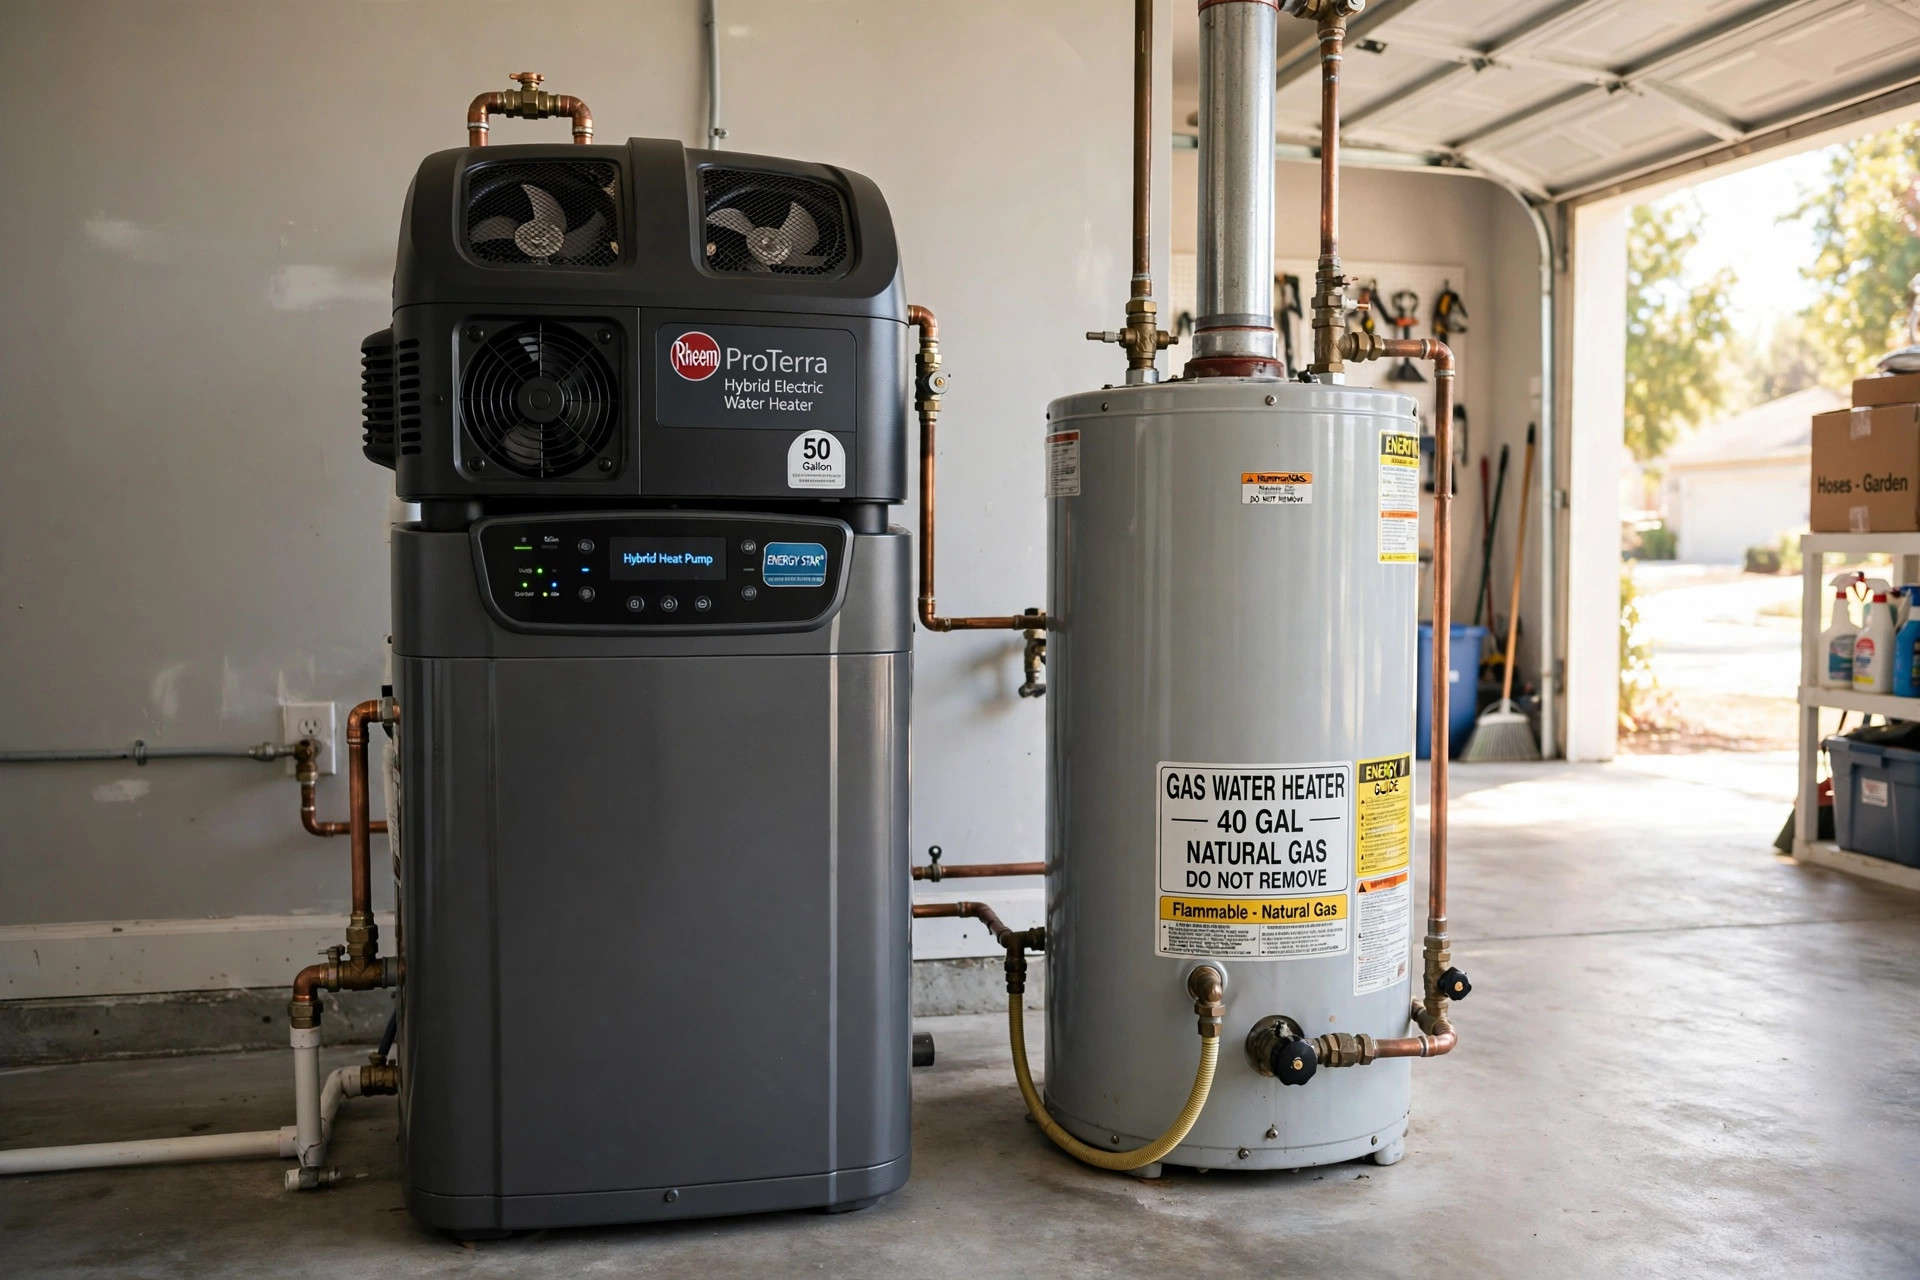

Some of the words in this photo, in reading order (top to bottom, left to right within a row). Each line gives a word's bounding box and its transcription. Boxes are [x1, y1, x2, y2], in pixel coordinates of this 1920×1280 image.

[675, 339, 718, 369] Rheem
[726, 347, 828, 374] ProTerra
[724, 378, 770, 396] Hybrid
[774, 379, 824, 394] Electric
[724, 395, 765, 410] Water
[769, 397, 814, 412] Heater
[803, 437, 831, 460] 50
[802, 461, 832, 471] Gallon
[1817, 476, 1852, 494] Hoses
[1863, 472, 1908, 493] Garden
[623, 552, 657, 566] Hybrid
[659, 553, 683, 564] Heat
[684, 553, 714, 566] Pump
[767, 554, 800, 566] ENERGY
[1166, 772, 1206, 801] GAS
[1212, 774, 1276, 801] WATER
[1282, 772, 1346, 800] HEATER
[1217, 809, 1247, 834] 40
[1255, 808, 1304, 834] GAL
[1186, 840, 1282, 865] NATURAL
[1288, 838, 1327, 864] GAS
[1186, 870, 1211, 888] DO
[1217, 871, 1254, 889] NOT
[1259, 868, 1327, 889] REMOVE
[1172, 901, 1248, 920] Flammable
[1261, 902, 1310, 919] Natural
[1313, 901, 1338, 917] Gas
